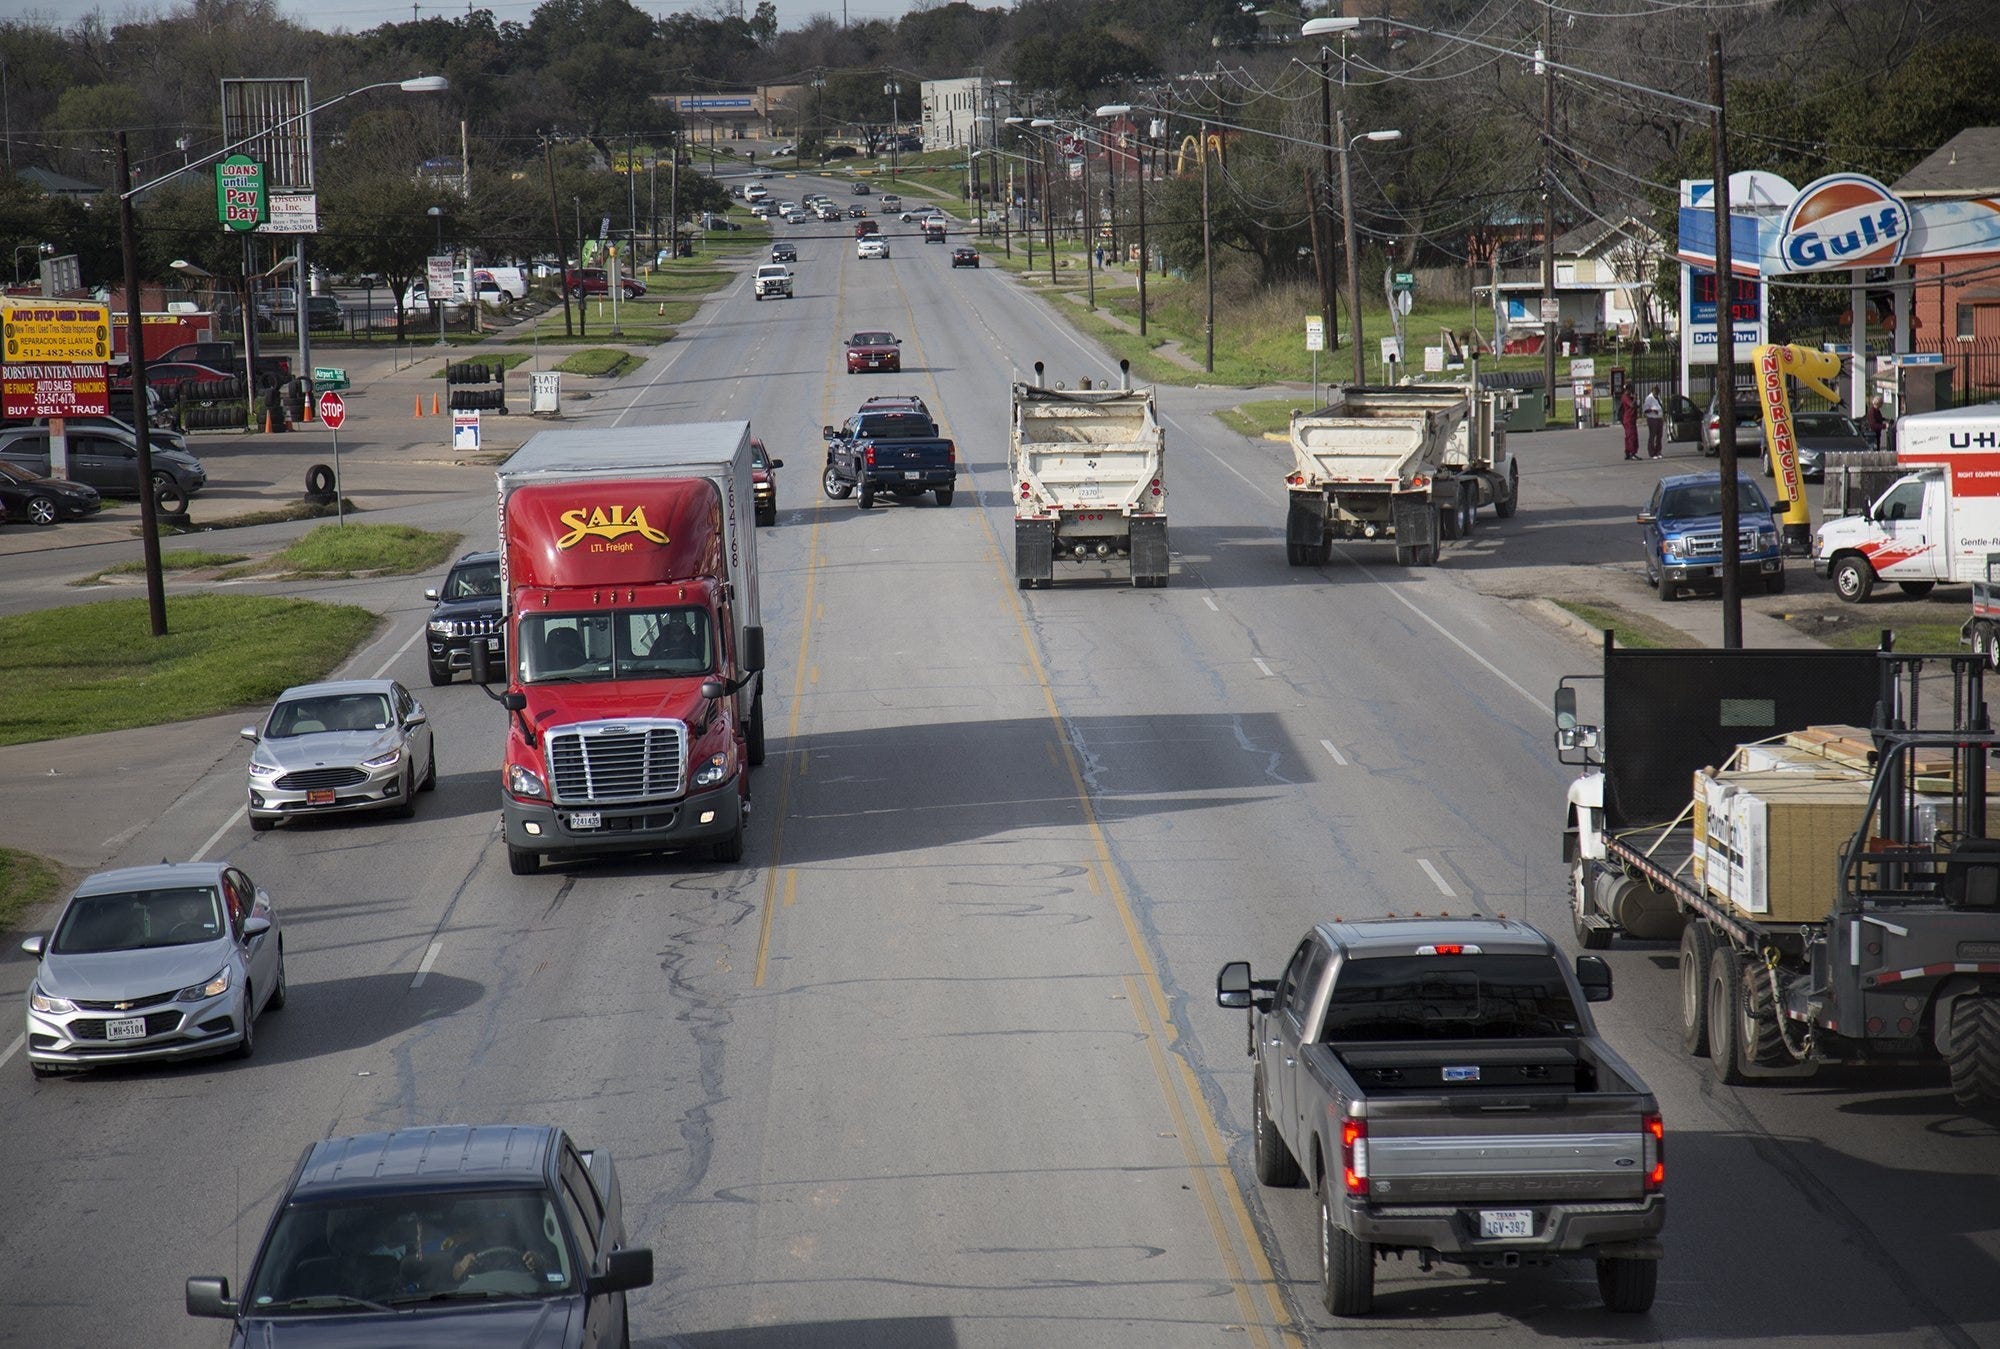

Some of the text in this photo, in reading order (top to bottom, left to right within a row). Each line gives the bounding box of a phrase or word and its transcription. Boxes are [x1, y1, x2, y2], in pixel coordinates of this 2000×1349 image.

[222, 165, 257, 176] LOANS
[226, 189, 257, 206] Pay
[227, 205, 258, 223] Day
[1788, 207, 1899, 267] Gulf
[12, 310, 33, 321] AUTO
[34, 310, 55, 321] STOP
[67, 337, 94, 345] LLANTAS
[1695, 333, 1719, 343] Driv
[22, 349, 94, 357] 512-482-8568
[2, 365, 105, 379] BOBSEWEN INTERNATIONAL
[4, 384, 12, 394] WE
[13, 383, 35, 394] FINANCE
[36, 381, 53, 391] AUTO
[53, 380, 72, 391] SALES
[34, 393, 76, 405] 512-547-6178
[8, 405, 104, 415] BUY SELL TRADE
[322, 402, 343, 417] STOP
[1949, 431, 2000, 449] U-H
[556, 505, 671, 550] SAIA
[590, 542, 634, 553] LTL Freight
[1410, 1180, 1604, 1191] SUPER DUTY
